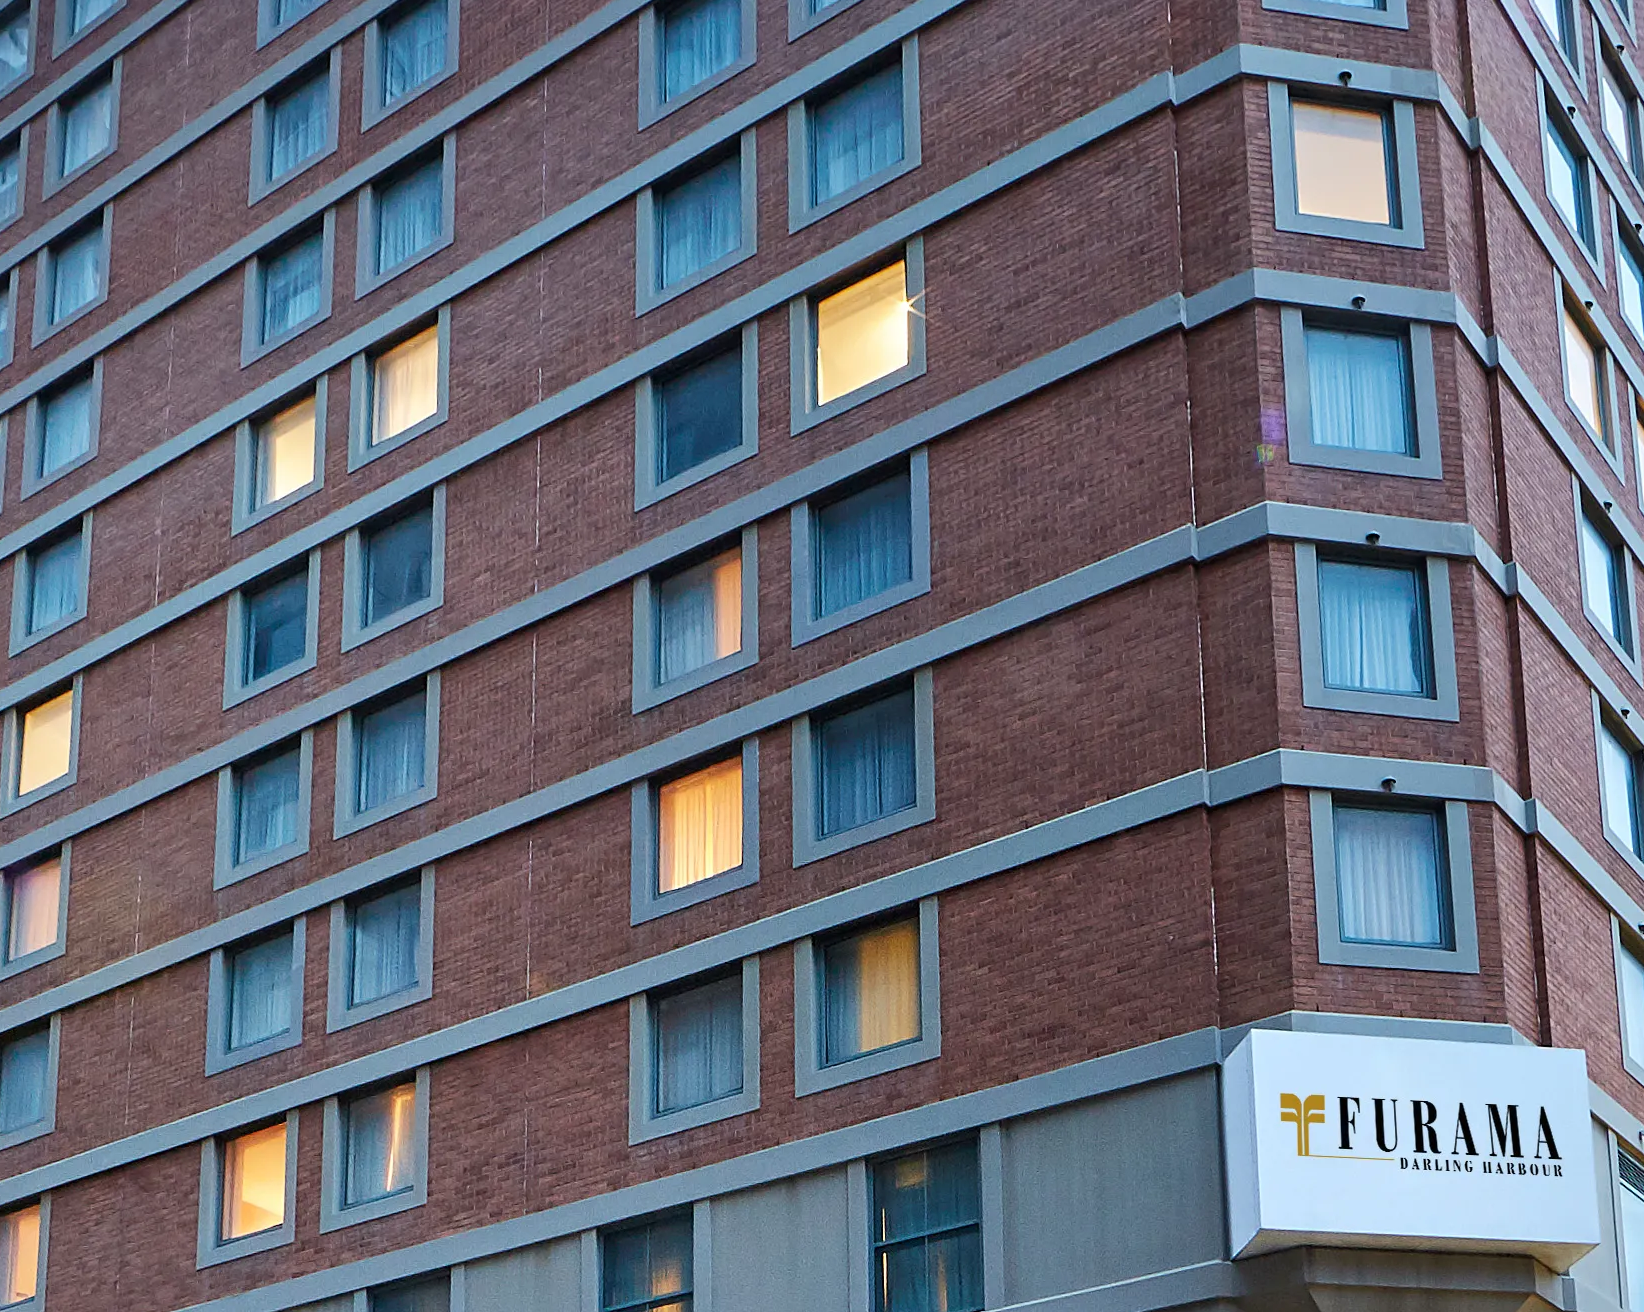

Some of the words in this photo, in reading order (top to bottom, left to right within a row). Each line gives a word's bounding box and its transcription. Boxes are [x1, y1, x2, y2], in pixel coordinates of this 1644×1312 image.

[1337, 1096, 1563, 1160] FURAMA
[1400, 1156, 1474, 1174] DARLING
[1482, 1159, 1564, 1178] HARBOUR
